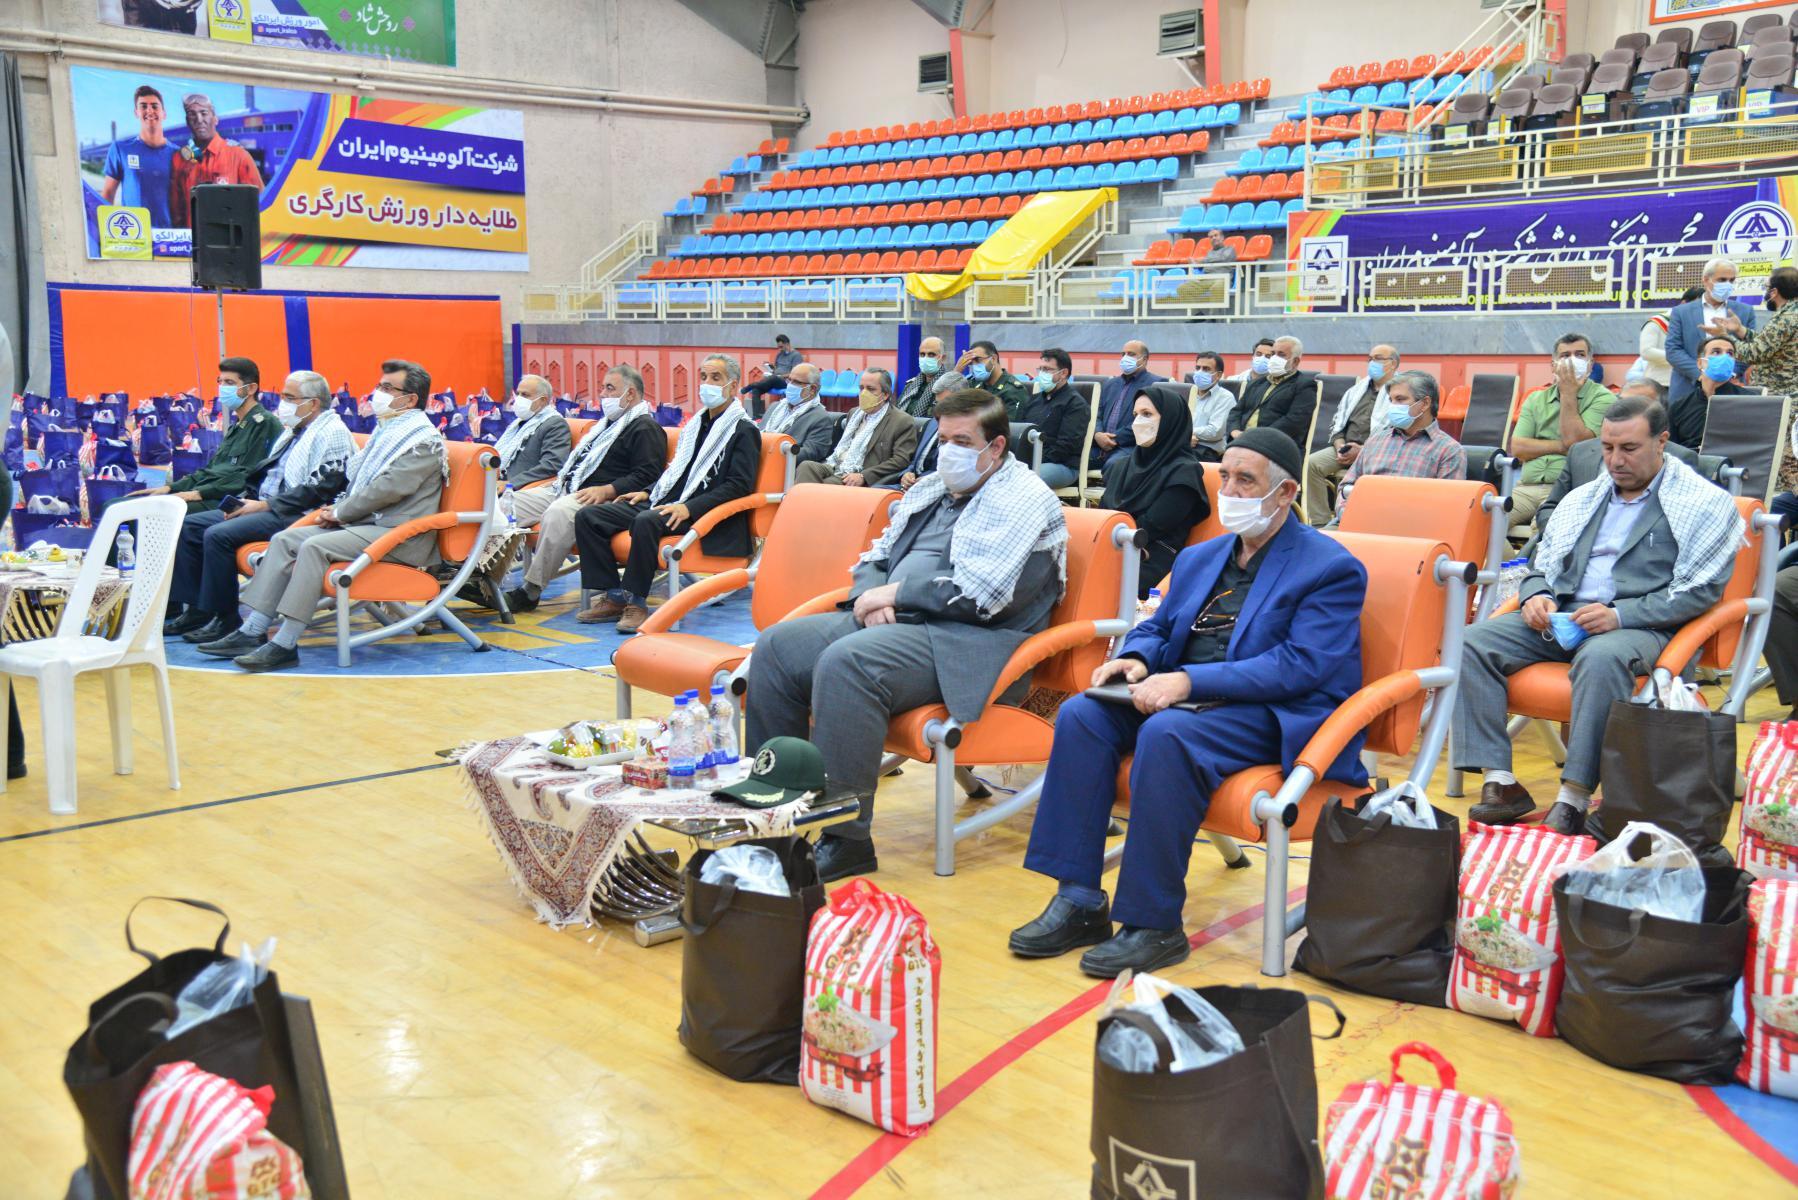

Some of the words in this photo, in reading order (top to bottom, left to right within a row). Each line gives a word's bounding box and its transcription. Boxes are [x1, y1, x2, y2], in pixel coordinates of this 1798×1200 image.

[356, 3, 374, 23] شاد
[365, 6, 399, 36] روحش
[338, 136, 386, 161] ایران
[385, 144, 474, 170] آلومینیوم
[472, 153, 518, 175] شرکت
[288, 187, 365, 218] کارگری
[368, 196, 430, 227] ورزش
[432, 205, 466, 229] دار
[468, 208, 518, 234] طلایه
[1488, 883, 1523, 901] GTC
[825, 954, 861, 976] GTC
